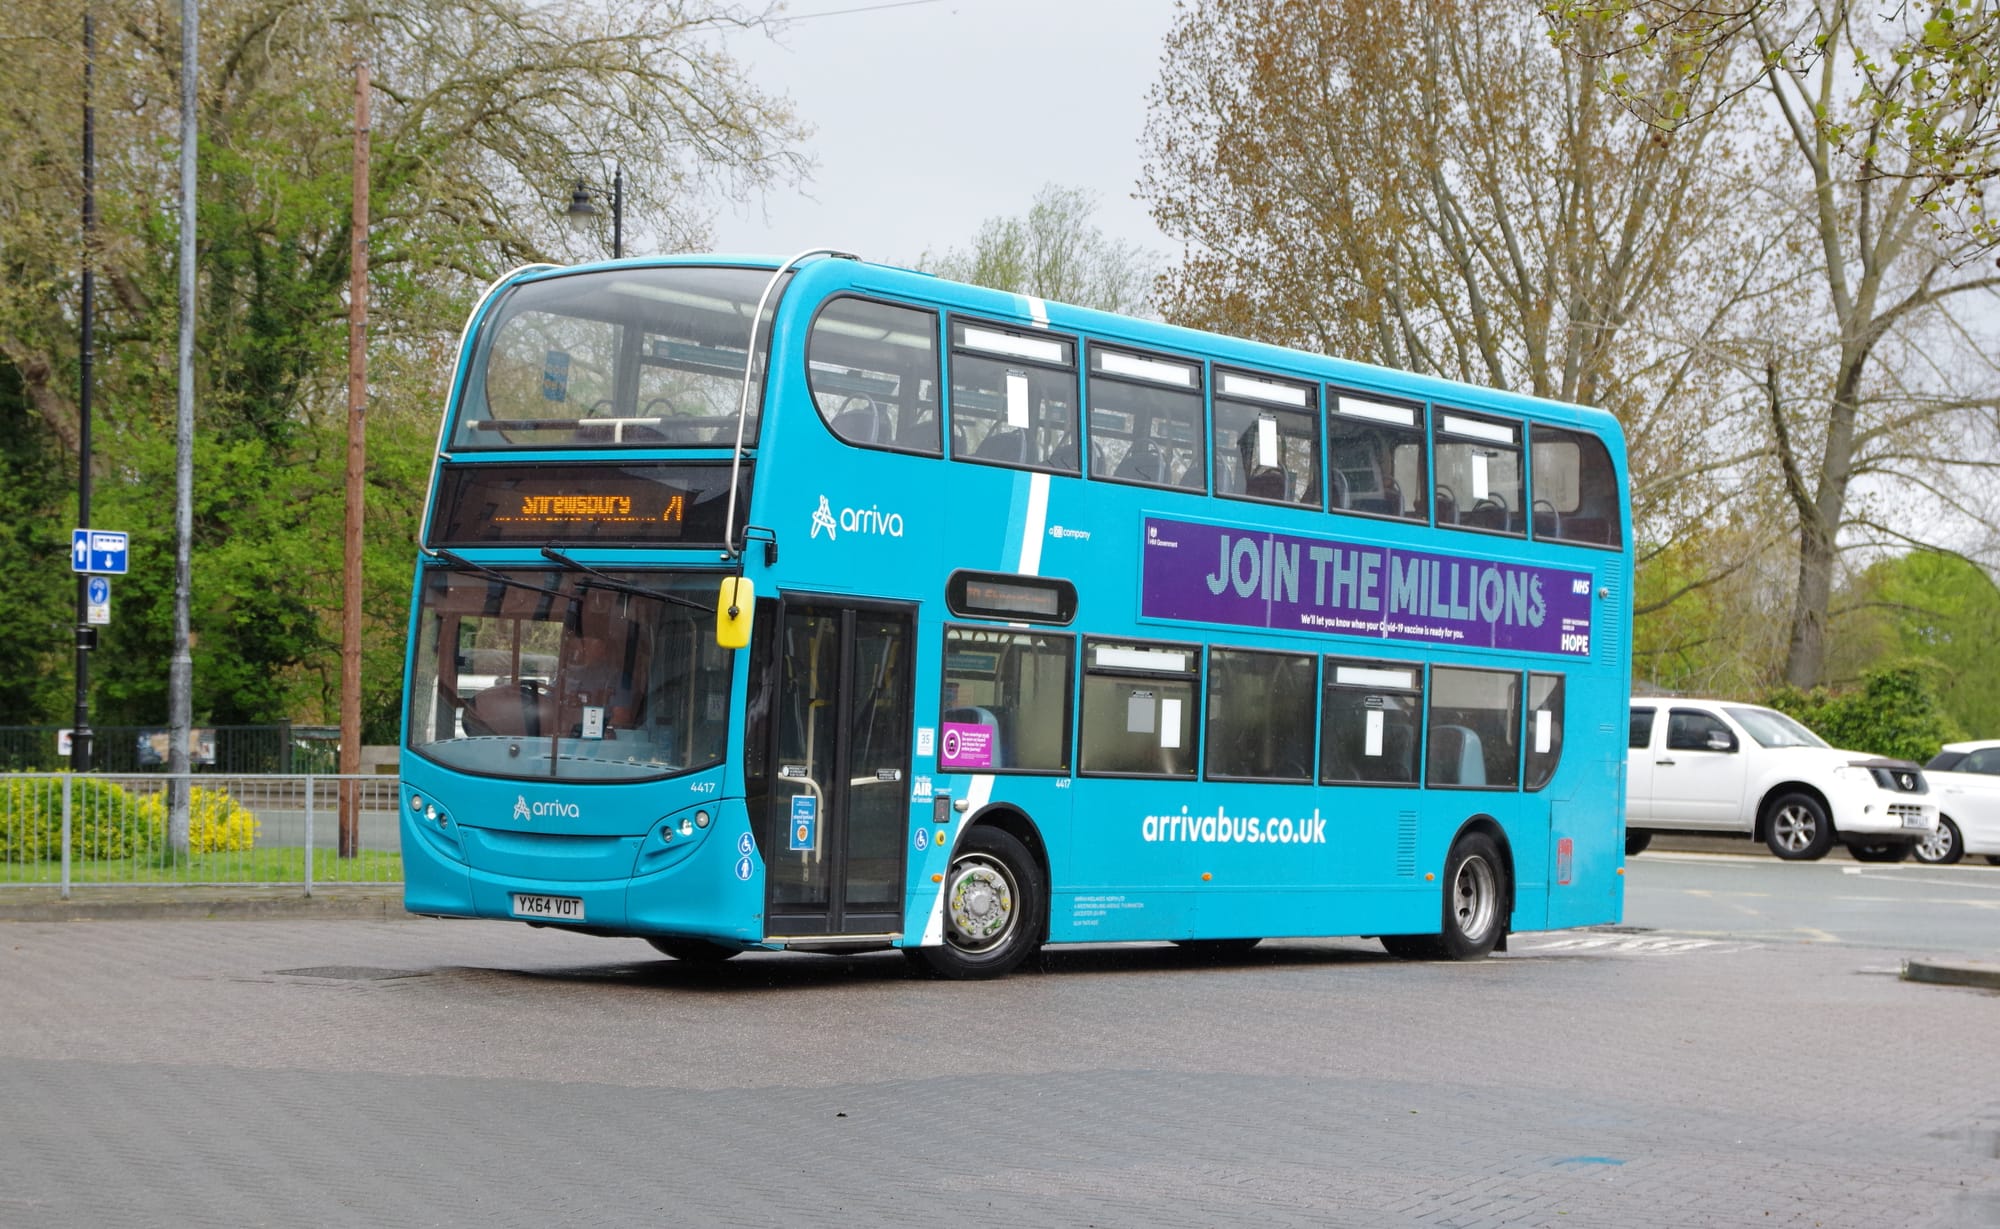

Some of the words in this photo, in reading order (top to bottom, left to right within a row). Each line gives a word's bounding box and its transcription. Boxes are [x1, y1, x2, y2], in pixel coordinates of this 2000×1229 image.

[840, 504, 904, 537] arriva
[1063, 528, 1091, 541] company
[1206, 534, 1300, 603] JOIN
[1309, 545, 1382, 611] THE
[1389, 556, 1547, 628] MILLIONS
[1572, 579, 1590, 595] NHS
[1325, 620, 1336, 629] you
[1336, 618, 1351, 628] know
[1351, 620, 1367, 630] when
[1366, 623, 1379, 632] your
[1379, 621, 1404, 633] Cvid-19
[921, 734, 930, 745] 35
[690, 782, 716, 794] 4417
[913, 782, 932, 796] AIR
[1055, 778, 1071, 789] 4417
[532, 799, 580, 818] arriva
[1142, 805, 1327, 843] arrivabus.co.uk
[519, 896, 552, 913] YX64
